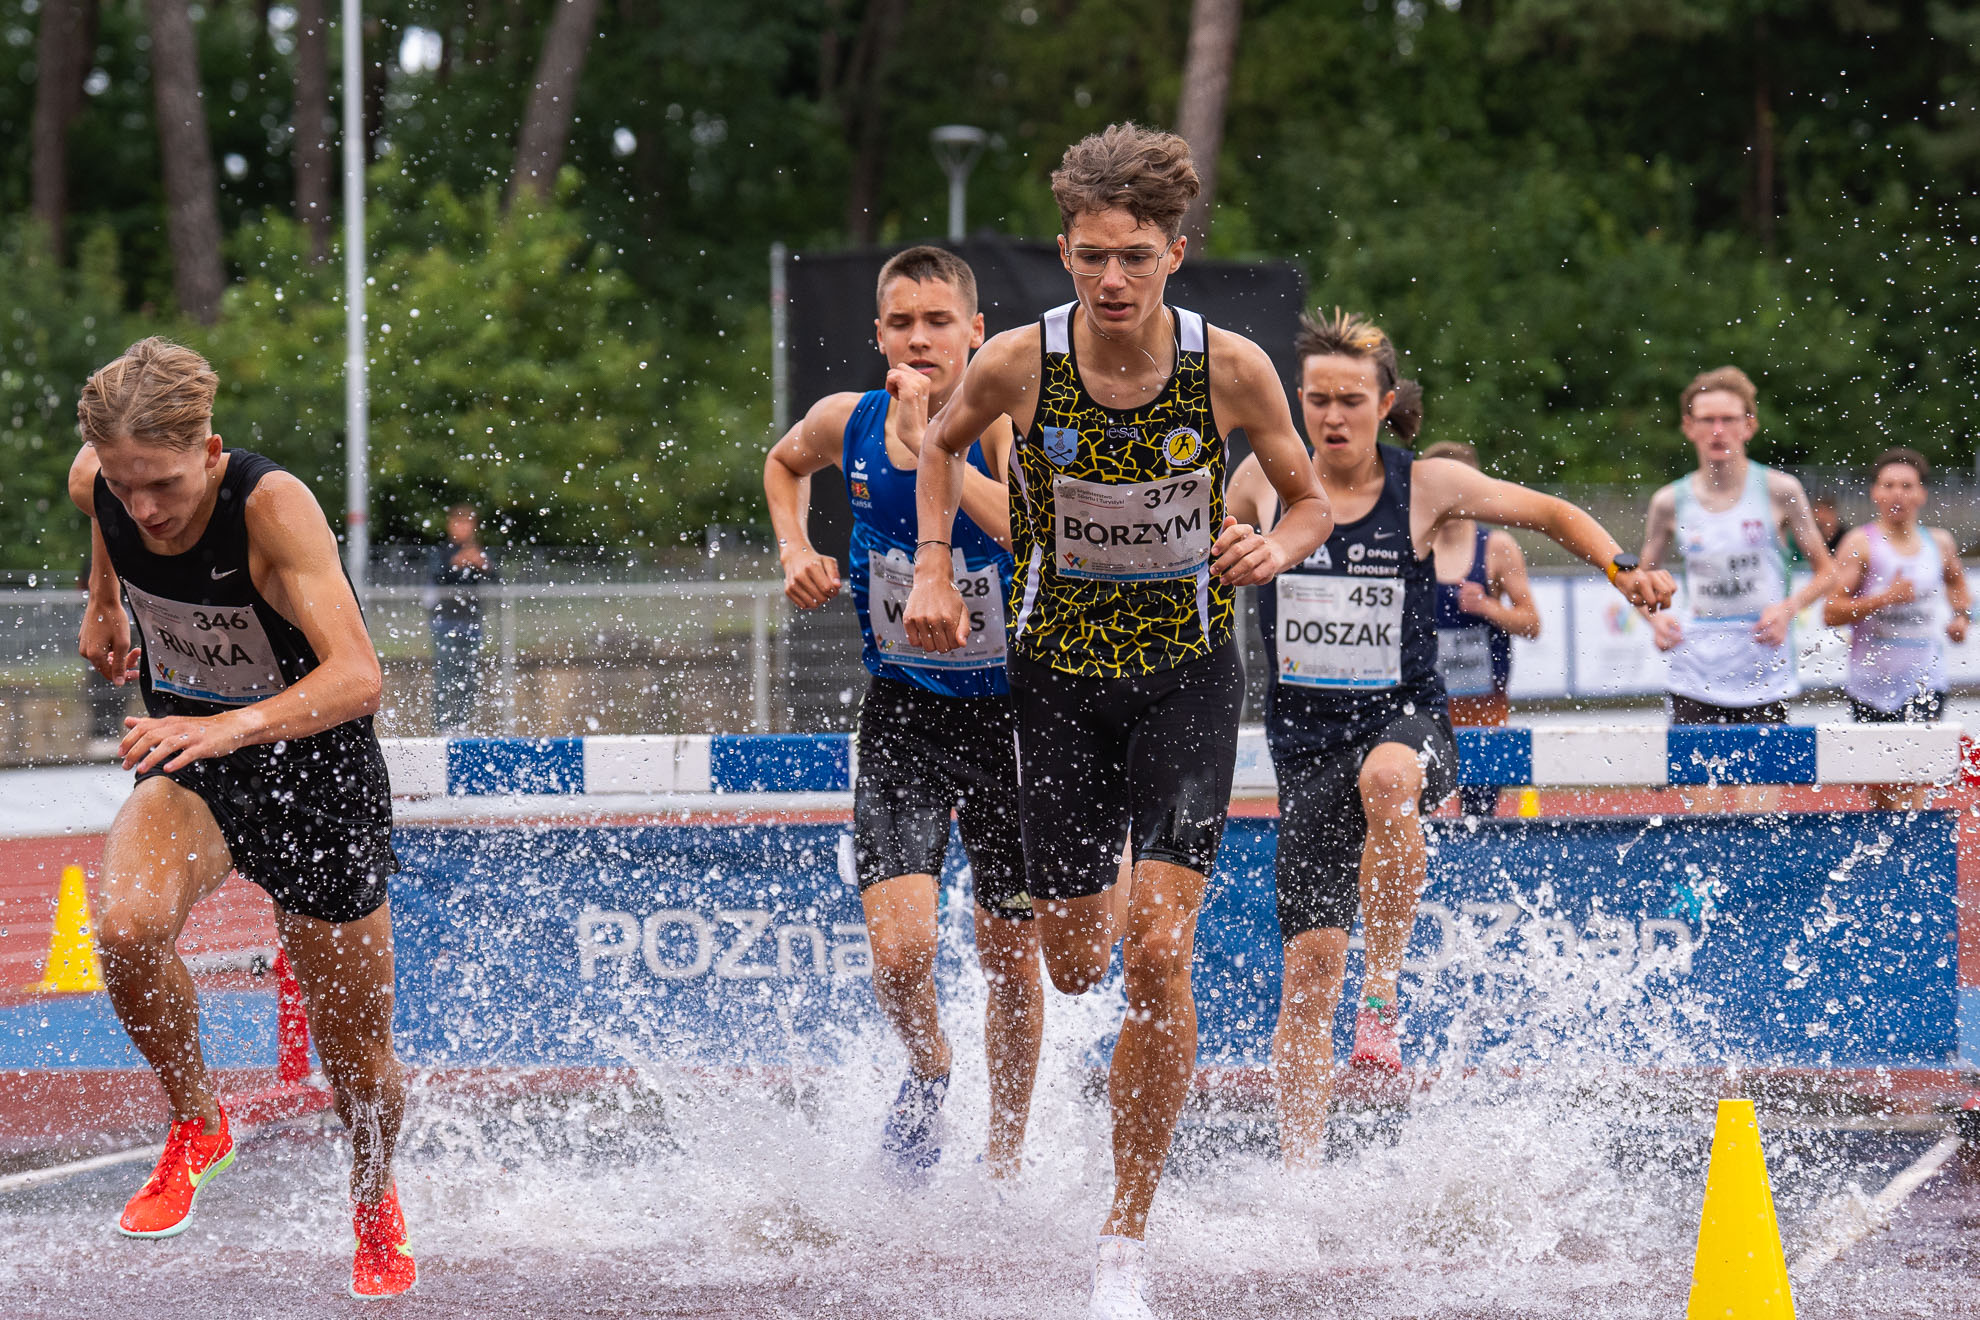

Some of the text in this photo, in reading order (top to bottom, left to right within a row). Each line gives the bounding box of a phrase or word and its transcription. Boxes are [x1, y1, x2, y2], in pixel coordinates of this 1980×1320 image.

[1143, 479, 1198, 509] 379
[1063, 507, 1201, 546] BORZYM
[1367, 548, 1399, 560] OPOLE
[957, 576, 990, 598] 28
[1348, 586, 1394, 607] 453
[192, 611, 249, 632] 346
[1285, 619, 1392, 646] DOSZAK
[158, 627, 255, 667] RULKA
[576, 909, 874, 979] POZna
